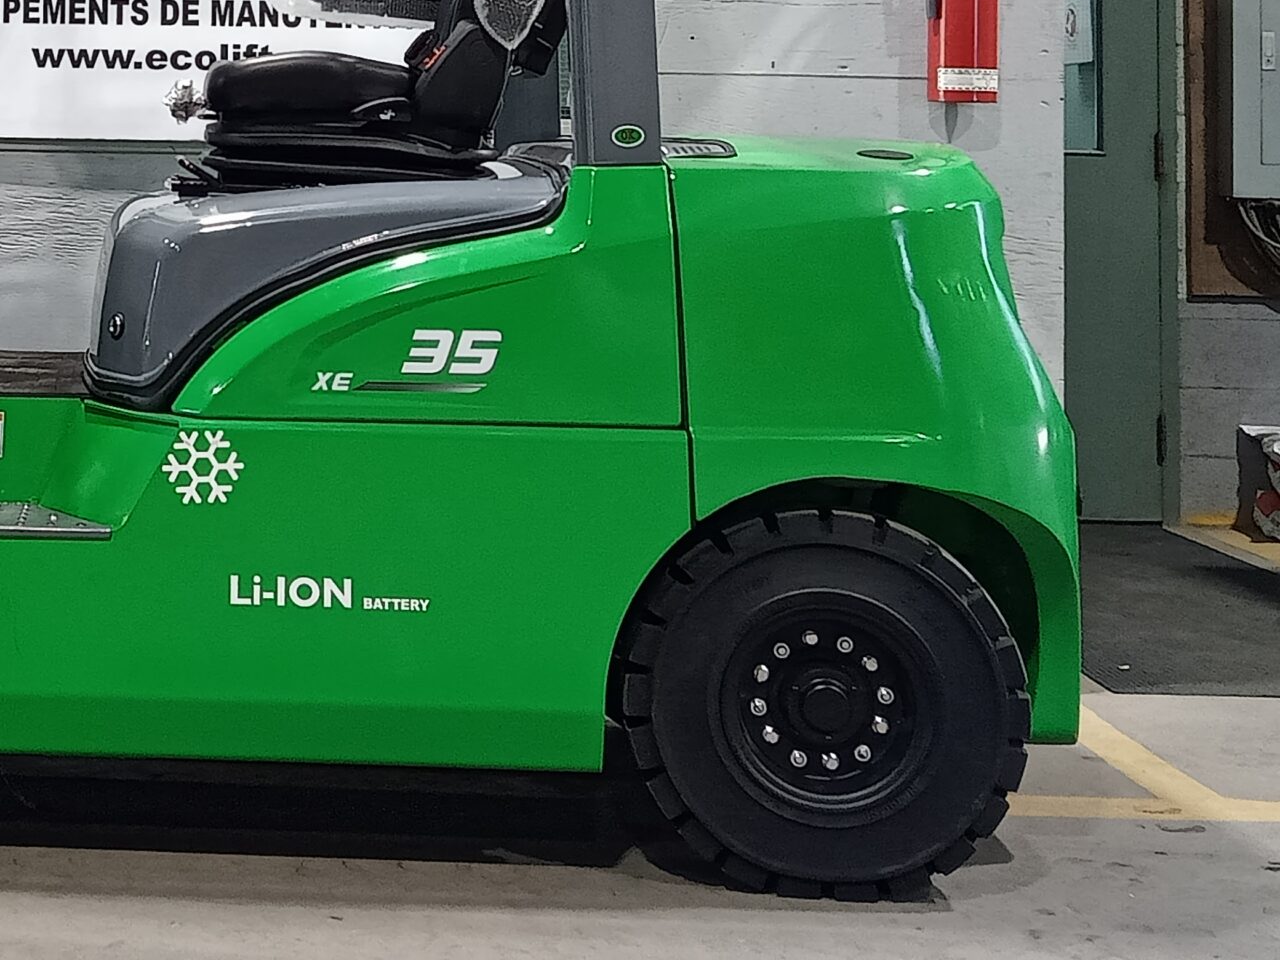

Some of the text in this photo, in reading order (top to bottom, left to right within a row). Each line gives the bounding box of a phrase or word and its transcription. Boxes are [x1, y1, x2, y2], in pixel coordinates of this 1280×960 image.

[160, 0, 200, 26] DE
[400, 328, 503, 375] 35
[310, 371, 355, 392] XE
[228, 574, 430, 612] Li-ION BATTERY
